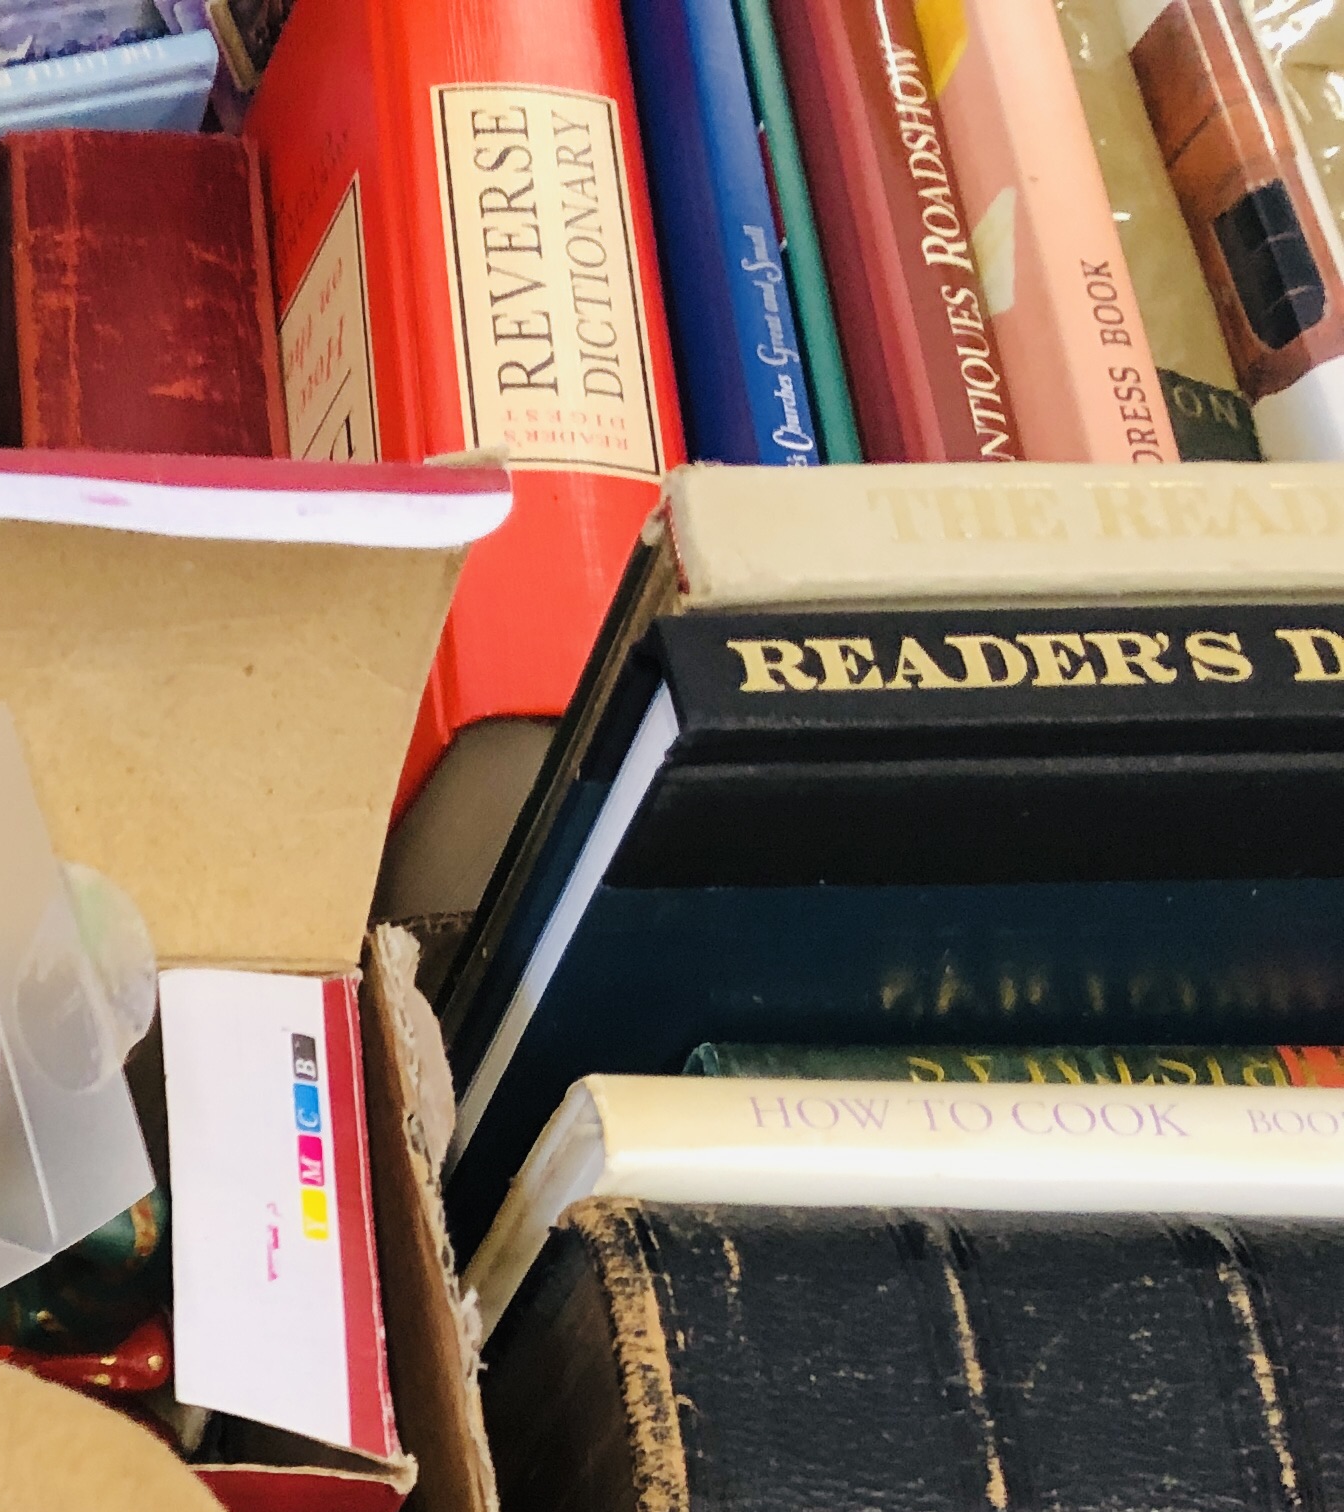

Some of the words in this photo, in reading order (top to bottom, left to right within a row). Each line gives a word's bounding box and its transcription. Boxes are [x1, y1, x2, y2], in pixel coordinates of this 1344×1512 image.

[882, 42, 975, 272] ROADSHOW
[470, 104, 560, 397] REVERSE
[551, 108, 626, 404] DICTIONARY
[1081, 259, 1134, 347] BOOK
[504, 429, 630, 453] READER'S
[505, 408, 628, 431] DIGEST
[866, 484, 1070, 542] THE
[727, 630, 1254, 693] READER'S
[296, 1058, 316, 1080] B
[298, 1107, 320, 1129] C
[750, 1095, 892, 1133] HOW
[907, 1098, 994, 1133] TO
[1011, 1100, 1190, 1138] COOK
[1247, 1108, 1344, 1135] BOO
[302, 1154, 323, 1185] M
